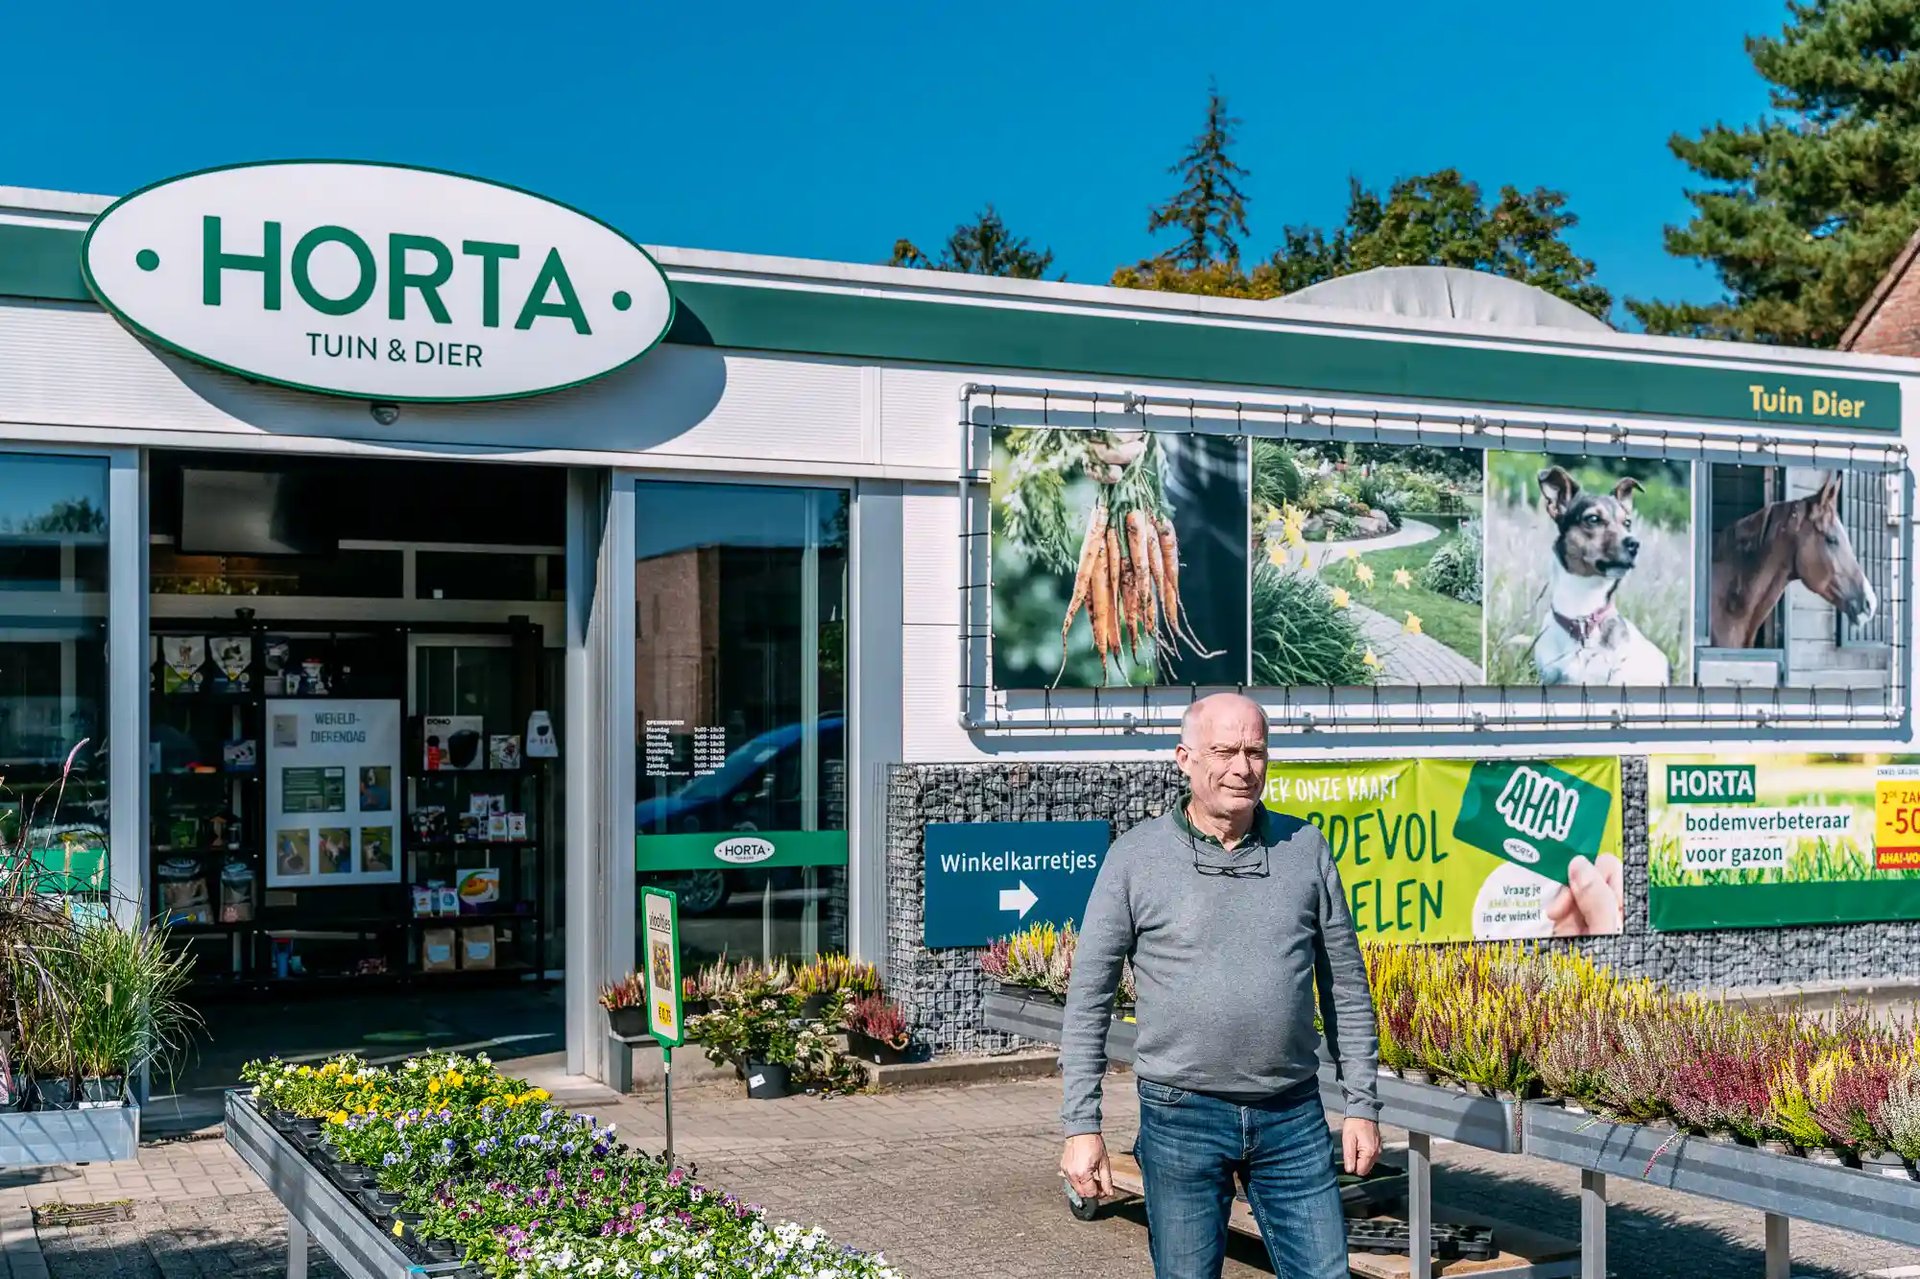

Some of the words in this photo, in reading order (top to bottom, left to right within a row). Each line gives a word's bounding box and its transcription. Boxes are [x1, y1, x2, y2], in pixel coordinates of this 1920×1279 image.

[203, 215, 592, 336] HORTA
[306, 332, 377, 361] TUIN
[388, 340, 406, 363] &
[415, 341, 484, 368] DIER
[1749, 385, 1803, 414] Tuin
[1812, 390, 1866, 419] Dier
[311, 730, 366, 743] DIERENDAG
[1295, 777, 1343, 802] ONZE
[1347, 774, 1401, 803] KAART
[1670, 770, 1754, 797] HORTA
[1499, 769, 1577, 837] AHA!
[1686, 811, 1850, 832] bodemverbeteraar
[725, 845, 766, 856] HORTA
[940, 850, 1097, 875] Winkelkarretjes
[1686, 849, 1725, 863] voor
[1731, 845, 1783, 866] gazon
[1879, 852, 1920, 865] AHA!-VO
[1503, 885, 1531, 897] Vraag
[1532, 884, 1541, 897] je
[1351, 878, 1444, 933] ELEN
[1483, 912, 1492, 923] in
[1494, 912, 1506, 922] de
[1507, 909, 1541, 922] winkel
